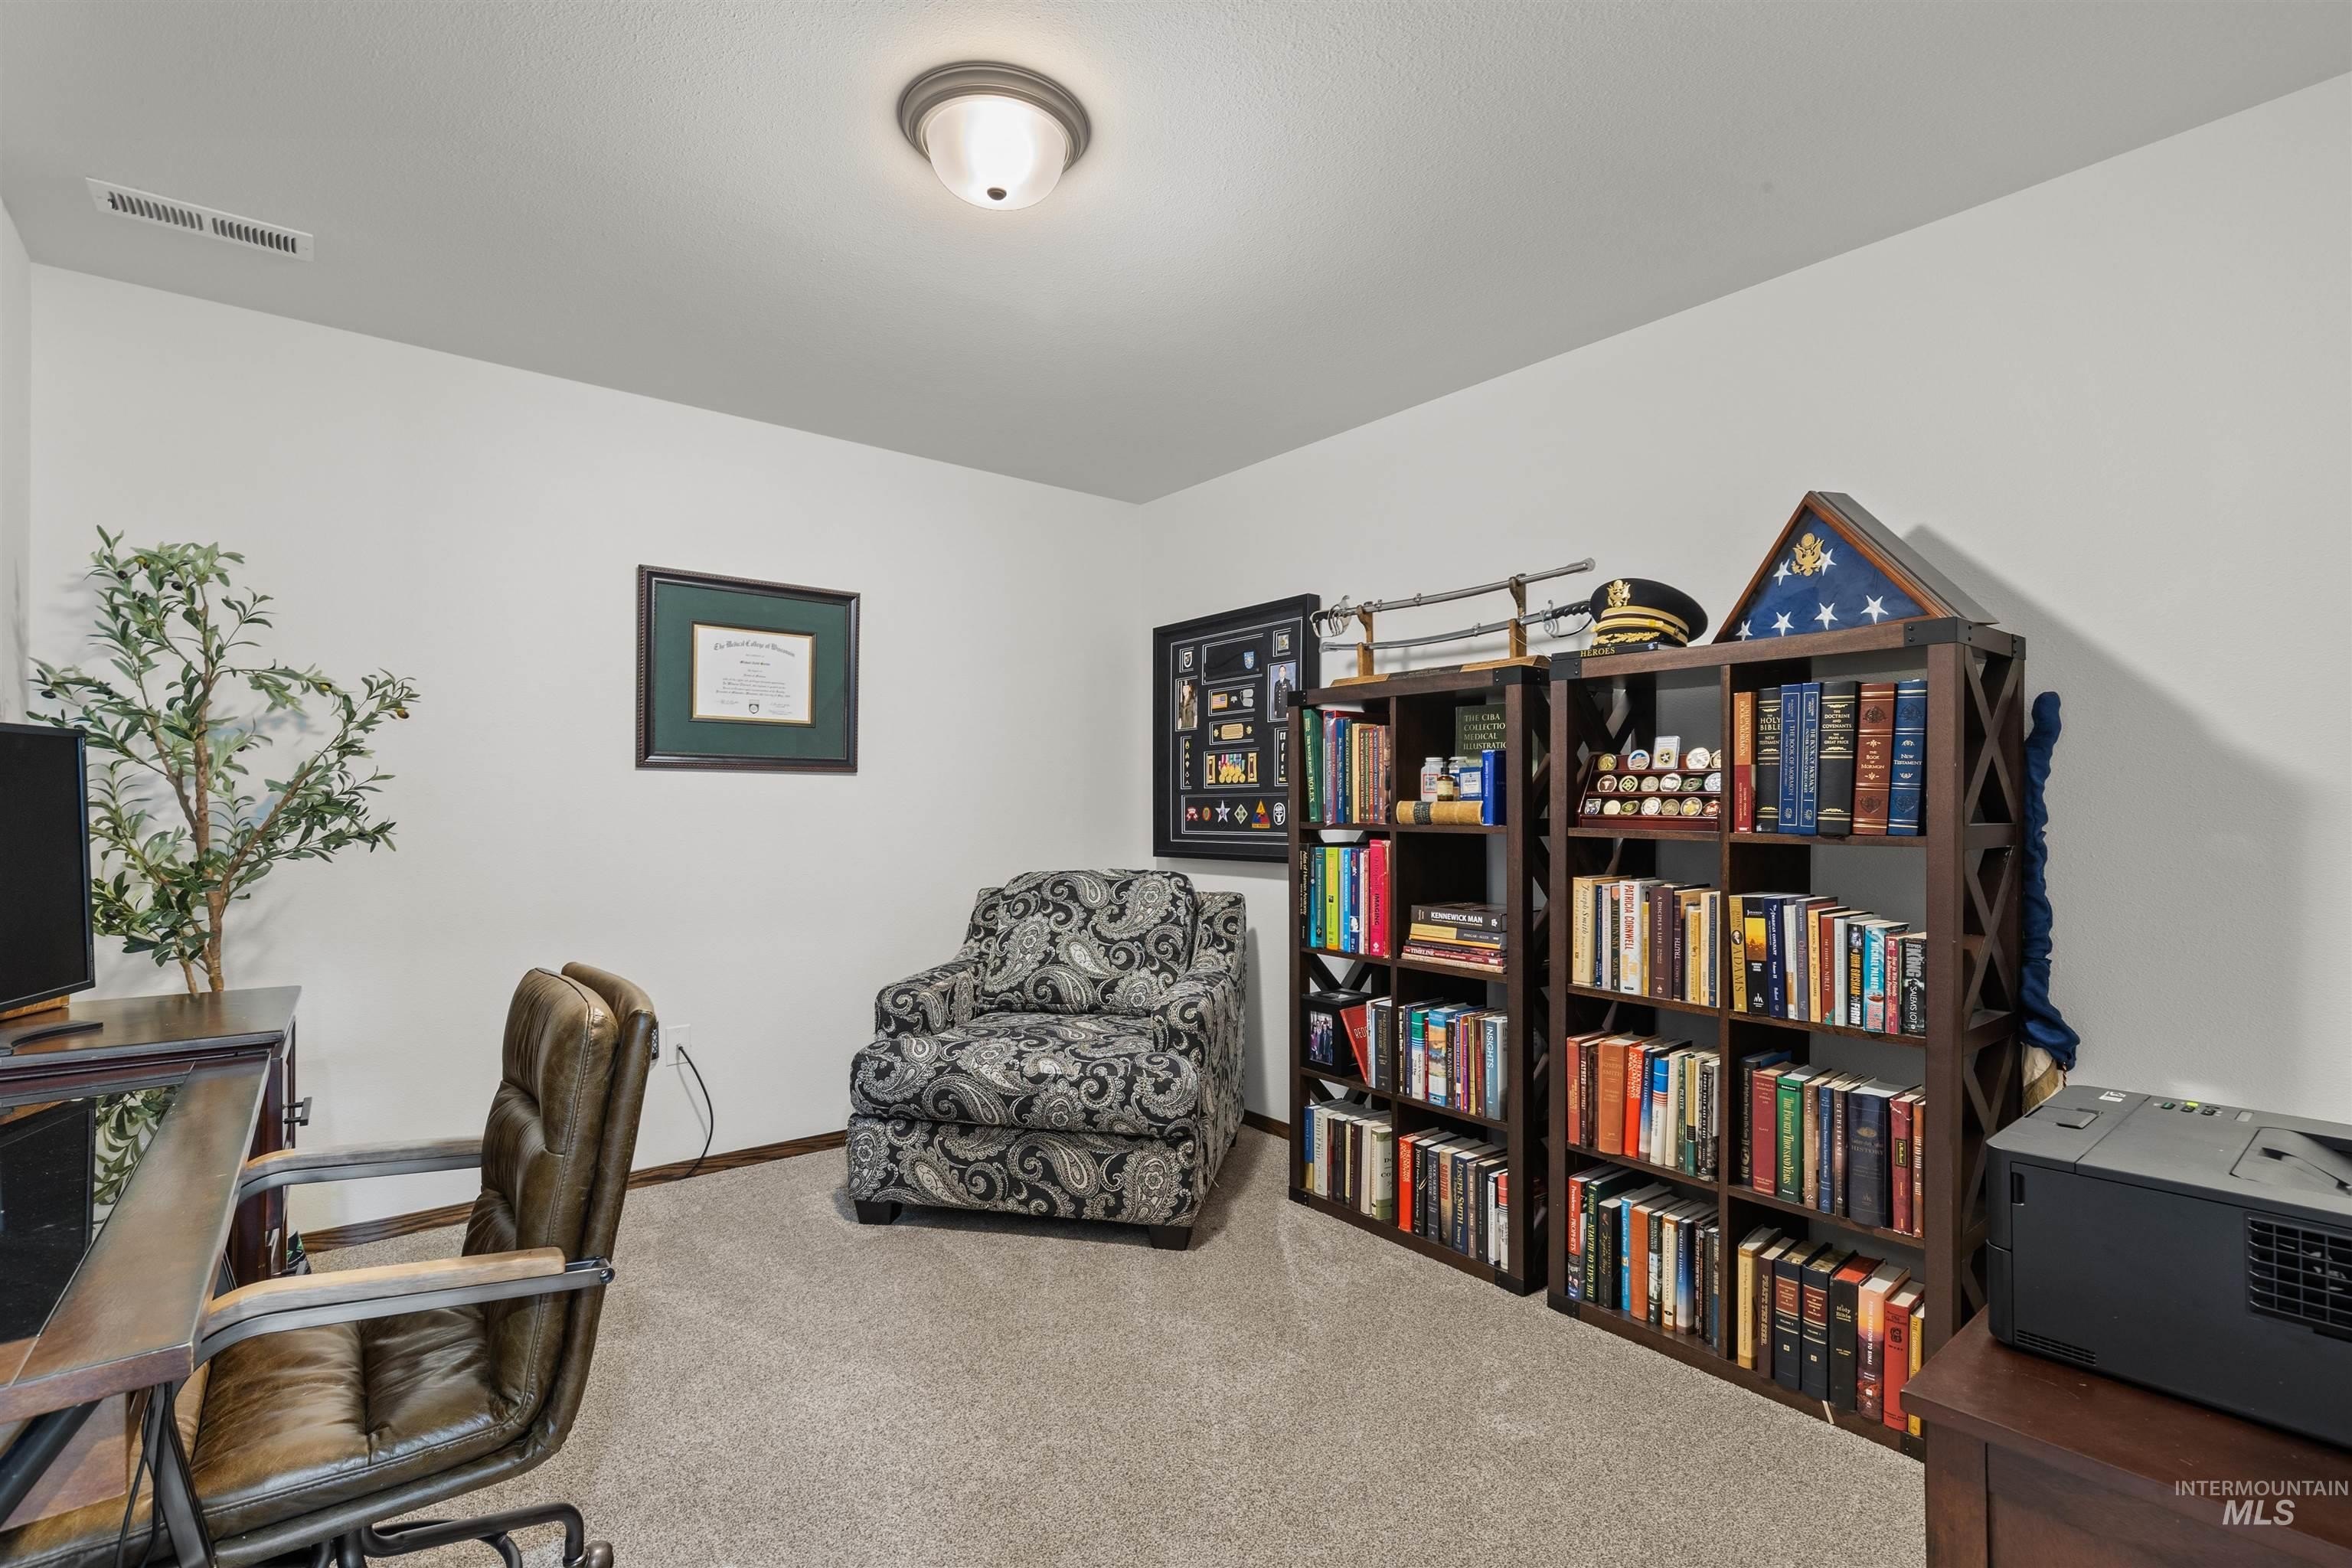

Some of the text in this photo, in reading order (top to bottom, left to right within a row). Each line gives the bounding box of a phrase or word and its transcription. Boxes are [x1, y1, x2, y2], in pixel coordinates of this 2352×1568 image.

[1580, 647, 1615, 657] HEROES
[1464, 723, 1506, 731] COLLECTIO
[1580, 884, 1589, 910] Joseph
[1431, 912, 1467, 922] KENNEWICK
[1624, 885, 1635, 950] PATRICIA CORNWELL
[1733, 946, 1743, 993] ADAMS
[1798, 941, 1806, 979] Otherwise
[1870, 942, 1879, 989] MICHAEL PALMER
[1906, 949, 1922, 978] KING
[1851, 952, 1860, 1024] JOHN GRISHAM FIRM
[1783, 1109, 1794, 1135] FOURTH
[1783, 1166, 1794, 1184] YEARS
[1587, 1253, 1594, 1263] OF
[1837, 1305, 1851, 1314] Holy
